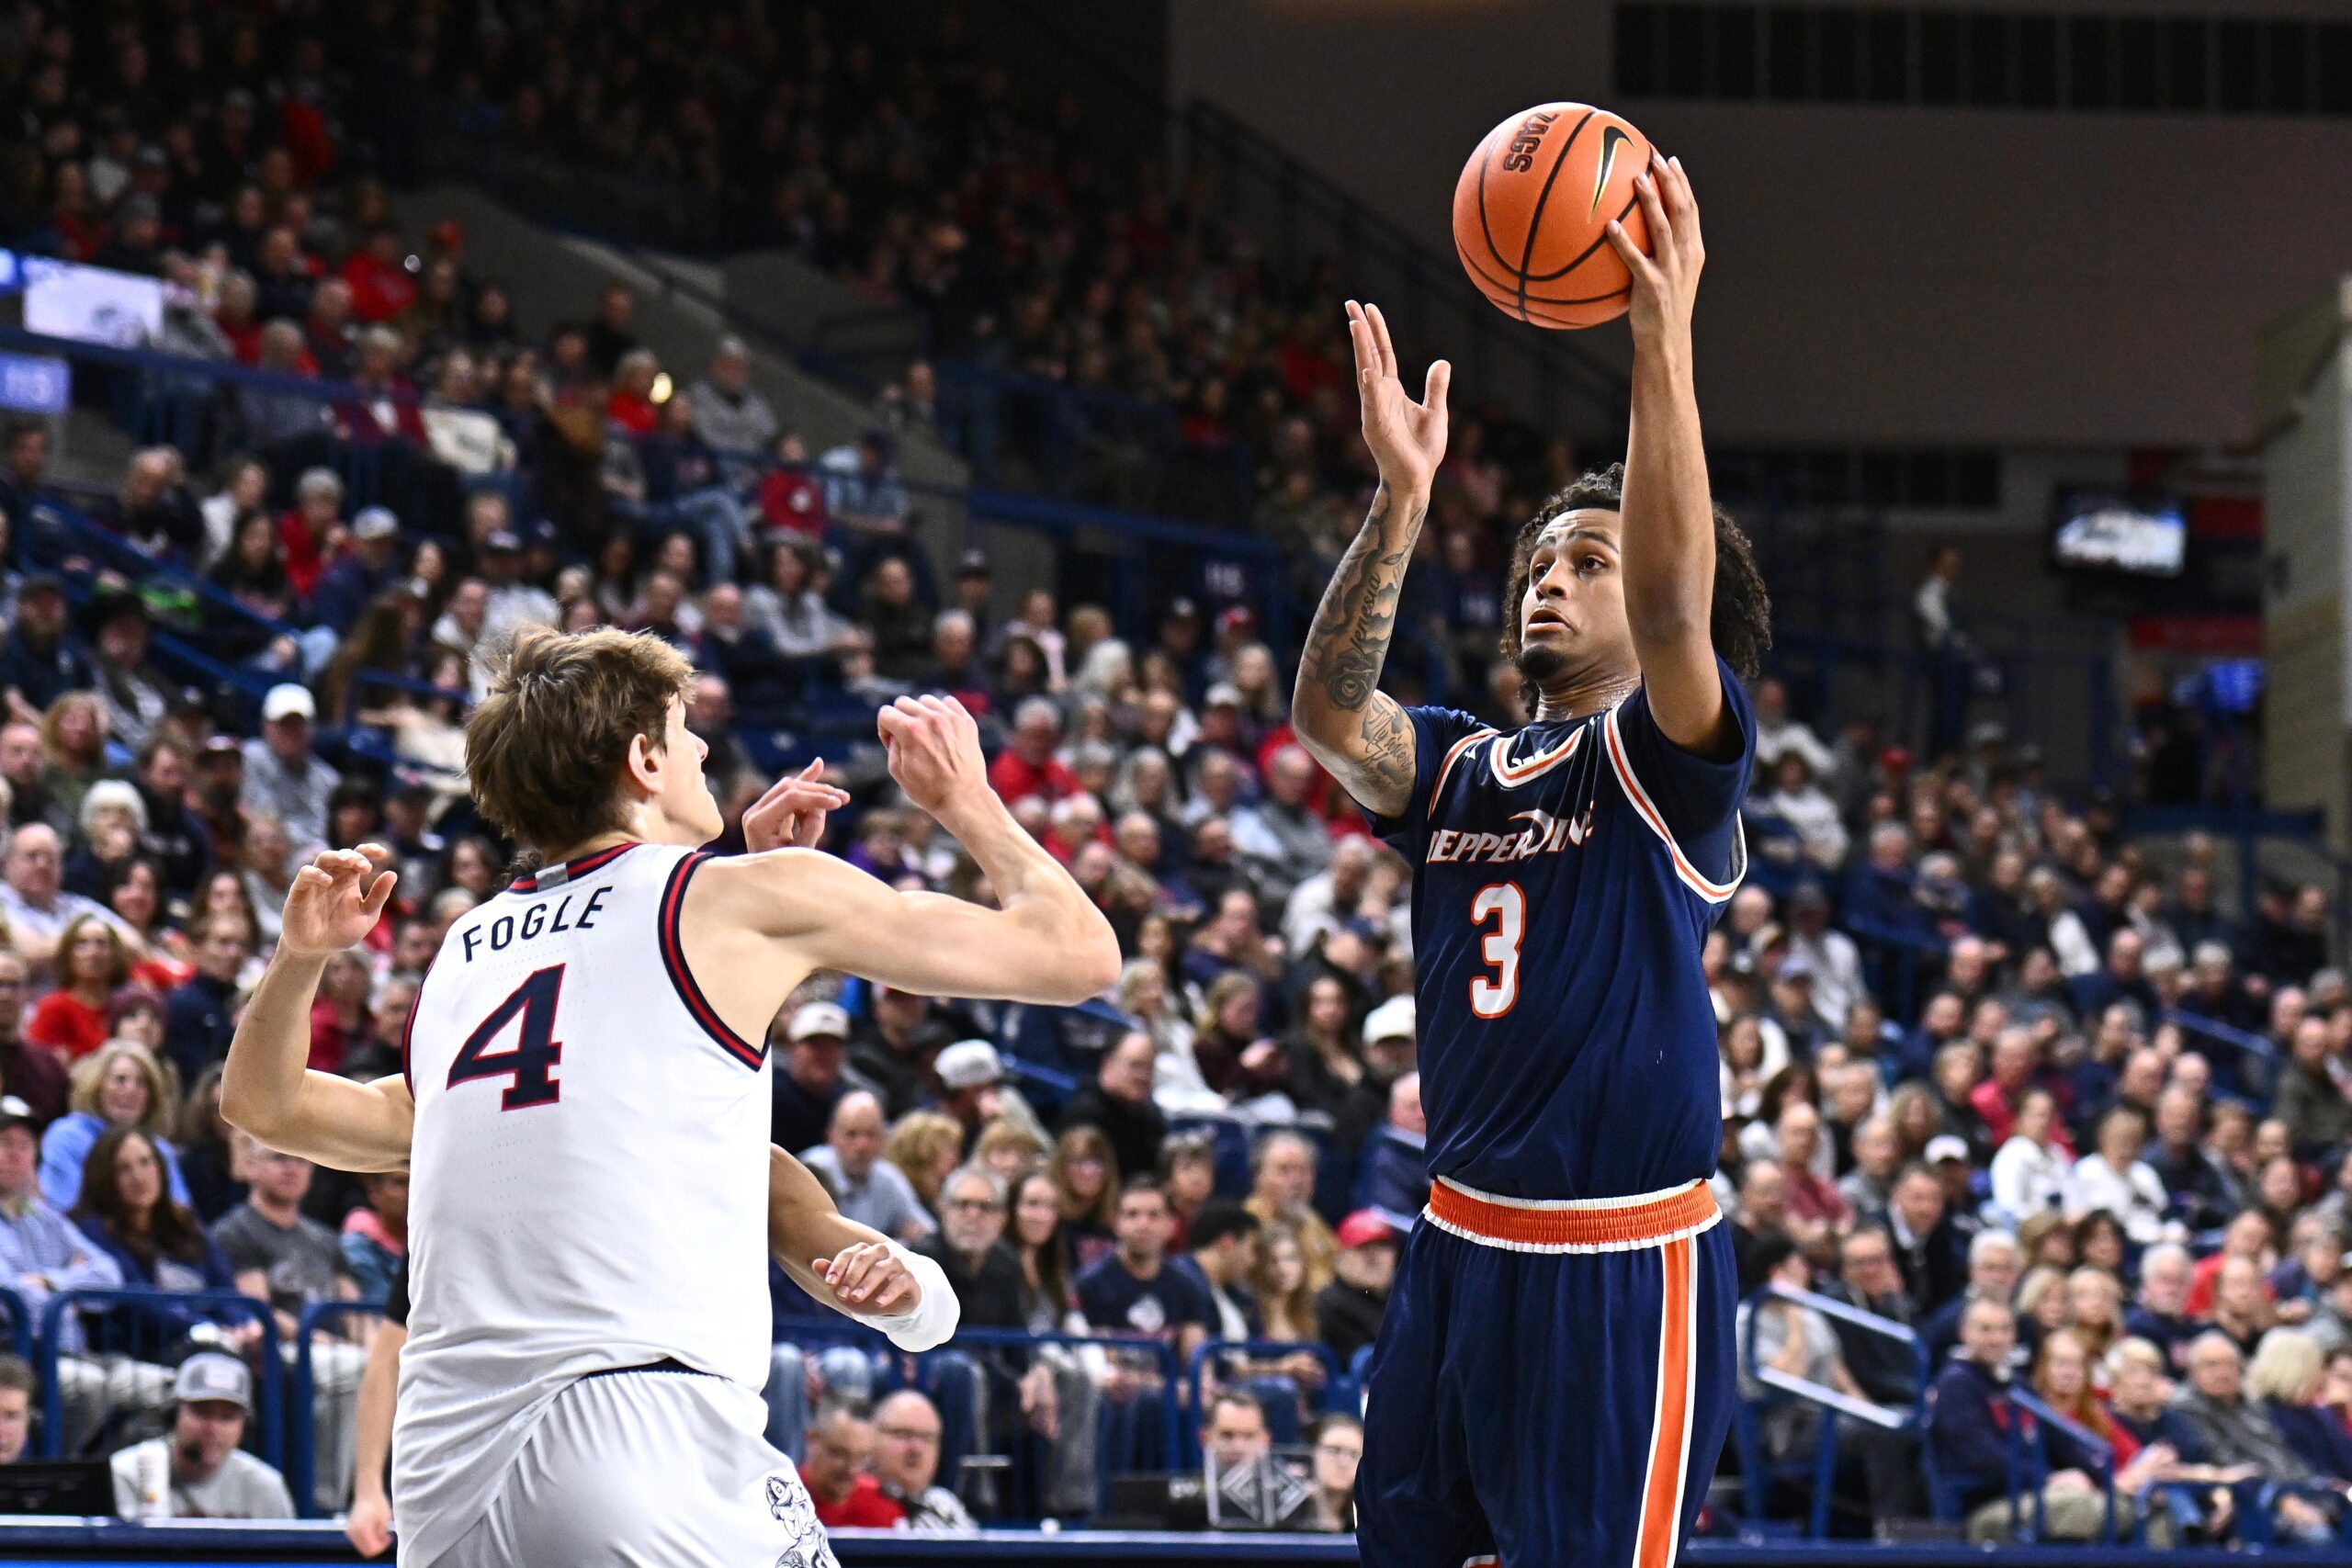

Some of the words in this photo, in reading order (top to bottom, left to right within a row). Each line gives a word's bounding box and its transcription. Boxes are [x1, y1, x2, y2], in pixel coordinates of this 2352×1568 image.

[462, 886, 614, 963] FOGLE
[1470, 880, 1527, 1020] 3
[446, 963, 566, 1112] 4
